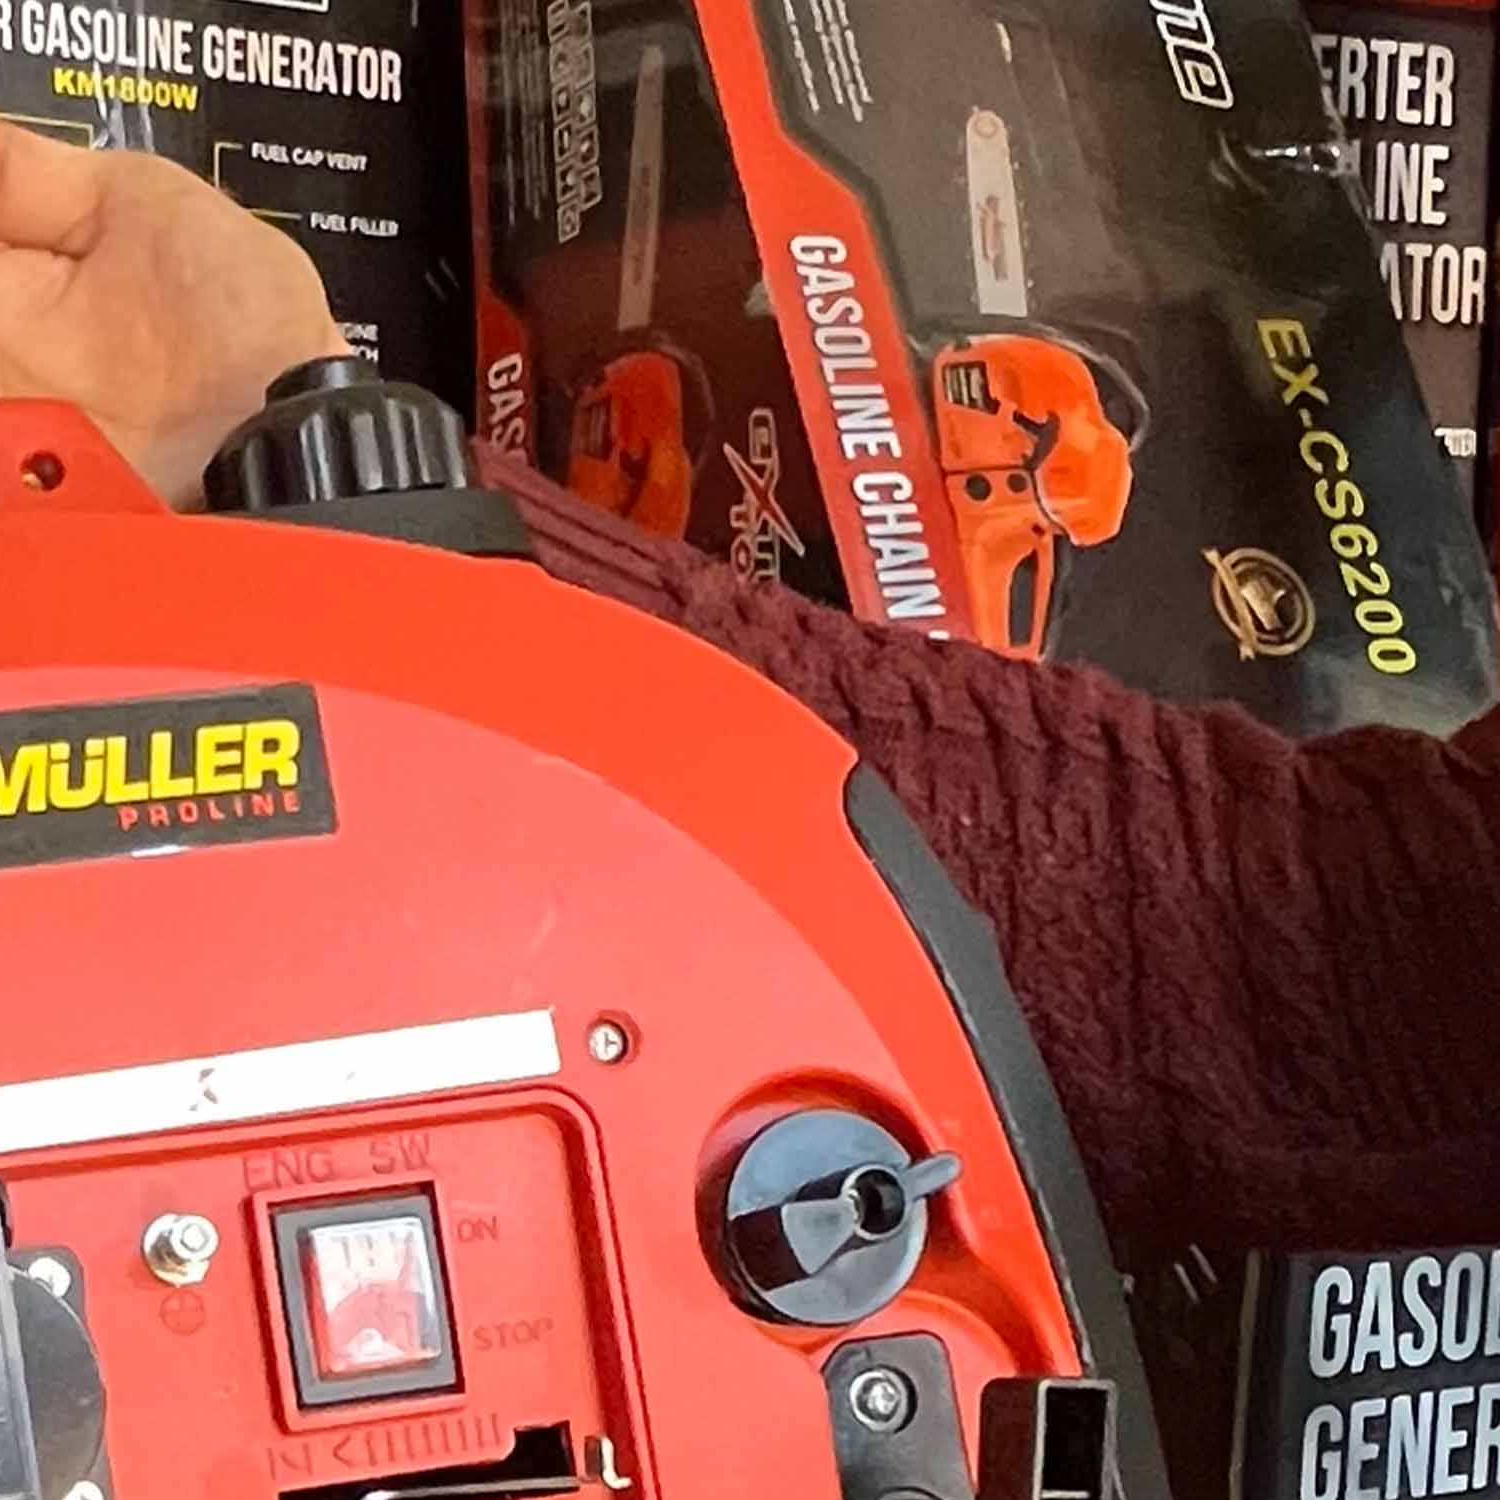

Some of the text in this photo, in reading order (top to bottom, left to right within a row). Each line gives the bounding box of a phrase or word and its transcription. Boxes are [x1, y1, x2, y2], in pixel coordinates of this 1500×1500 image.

[21, 0, 195, 76] GASOLINE
[202, 26, 403, 103] GENERATOR
[53, 67, 198, 111] KM1800W
[251, 142, 289, 164] FUEL
[292, 147, 324, 167] CAP
[311, 212, 347, 233] FUEL
[791, 235, 900, 460] GASOLINE
[853, 471, 939, 619] CHAIN
[1256, 318, 1417, 675] EX-CS6200
[116, 791, 302, 832] PROLINE
[242, 1134, 432, 1192] ENG SW
[457, 1215, 500, 1243] ON
[473, 1317, 554, 1350] STOP
